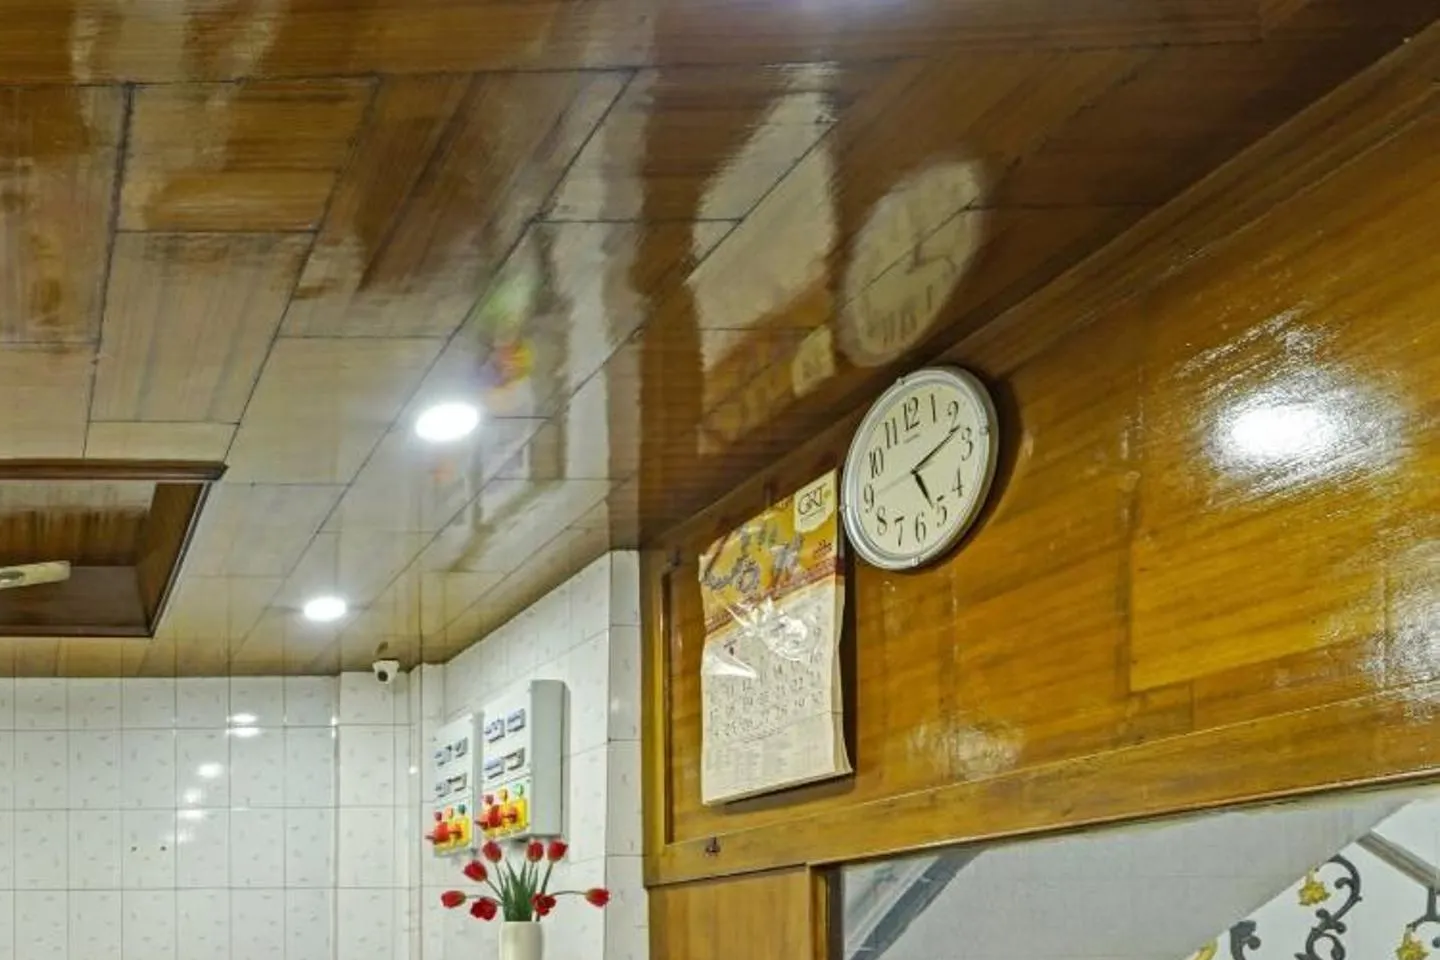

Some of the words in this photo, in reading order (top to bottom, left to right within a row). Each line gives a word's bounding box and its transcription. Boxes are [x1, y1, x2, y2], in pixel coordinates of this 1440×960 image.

[903, 397, 920, 431] 12
[947, 400, 960, 433] 2
[885, 417, 898, 449] 11
[961, 427, 974, 461] 3
[869, 447, 884, 479] 10
[864, 483, 875, 513] 9
[952, 468, 964, 498] 4
[877, 506, 888, 536] 8
[915, 512, 926, 543] 6
[936, 495, 948, 528] 5
[894, 516, 905, 547] 7
